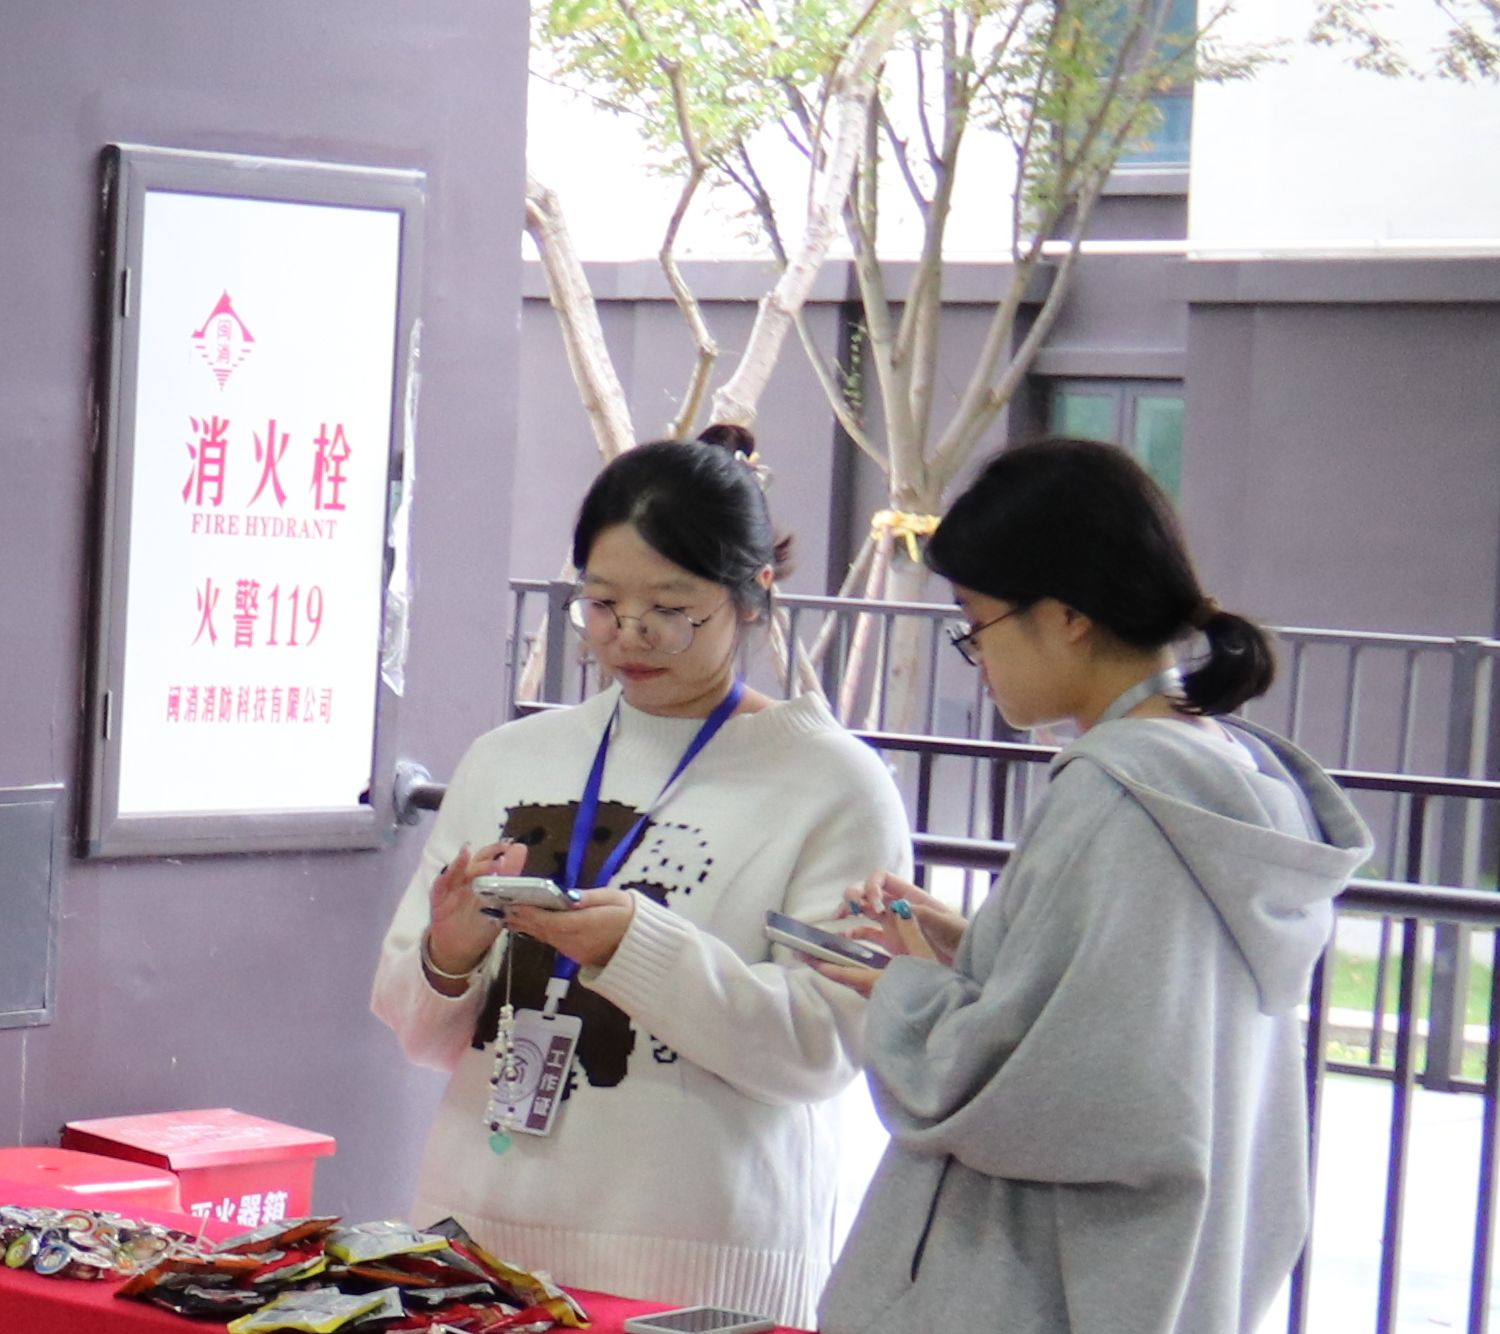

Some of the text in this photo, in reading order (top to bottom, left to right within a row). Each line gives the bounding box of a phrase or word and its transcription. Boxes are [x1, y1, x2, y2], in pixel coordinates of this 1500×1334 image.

[182, 415, 352, 511] 消火栓
[191, 513, 338, 540] FIRE HYDRANT
[192, 577, 324, 649] 火警119
